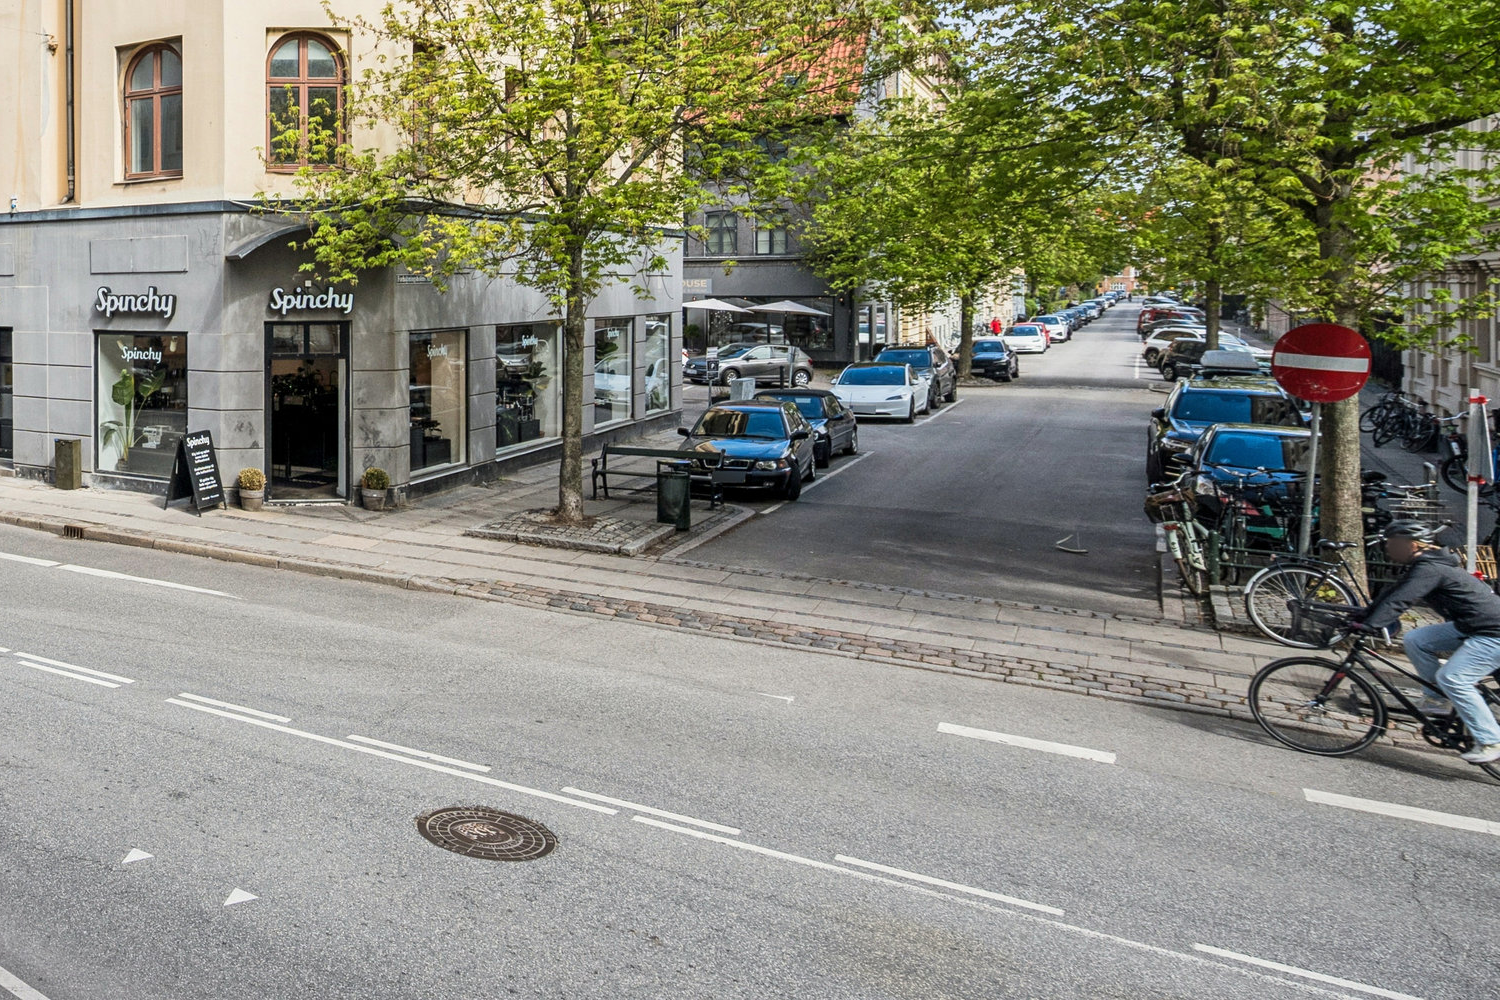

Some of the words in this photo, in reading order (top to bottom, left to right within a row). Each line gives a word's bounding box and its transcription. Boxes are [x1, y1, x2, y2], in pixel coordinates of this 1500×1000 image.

[96, 286, 173, 318] Spinchy
[270, 287, 354, 315] Spinchy
[521, 334, 539, 349] Spinchy
[121, 346, 162, 364] Spinchy
[427, 343, 447, 359] Spinchy
[187, 435, 209, 448] Spinchy
